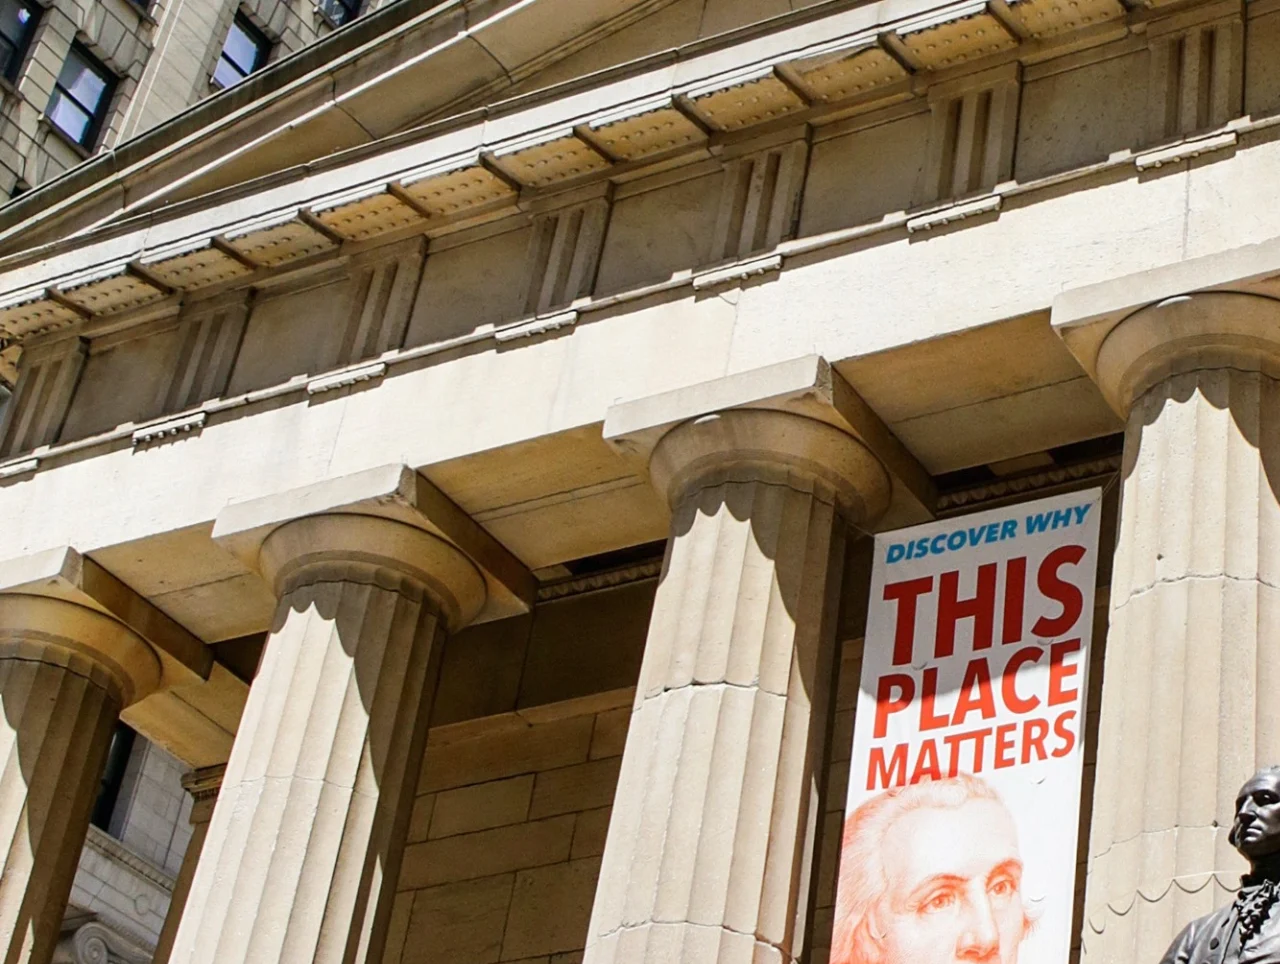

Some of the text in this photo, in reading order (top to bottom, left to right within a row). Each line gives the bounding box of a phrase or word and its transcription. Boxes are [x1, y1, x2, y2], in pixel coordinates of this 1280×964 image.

[886, 503, 1092, 564] DISCOVER WHY
[883, 544, 1086, 666] THIS
[873, 638, 1081, 738] PLACE
[866, 710, 1077, 790] MATTERS
